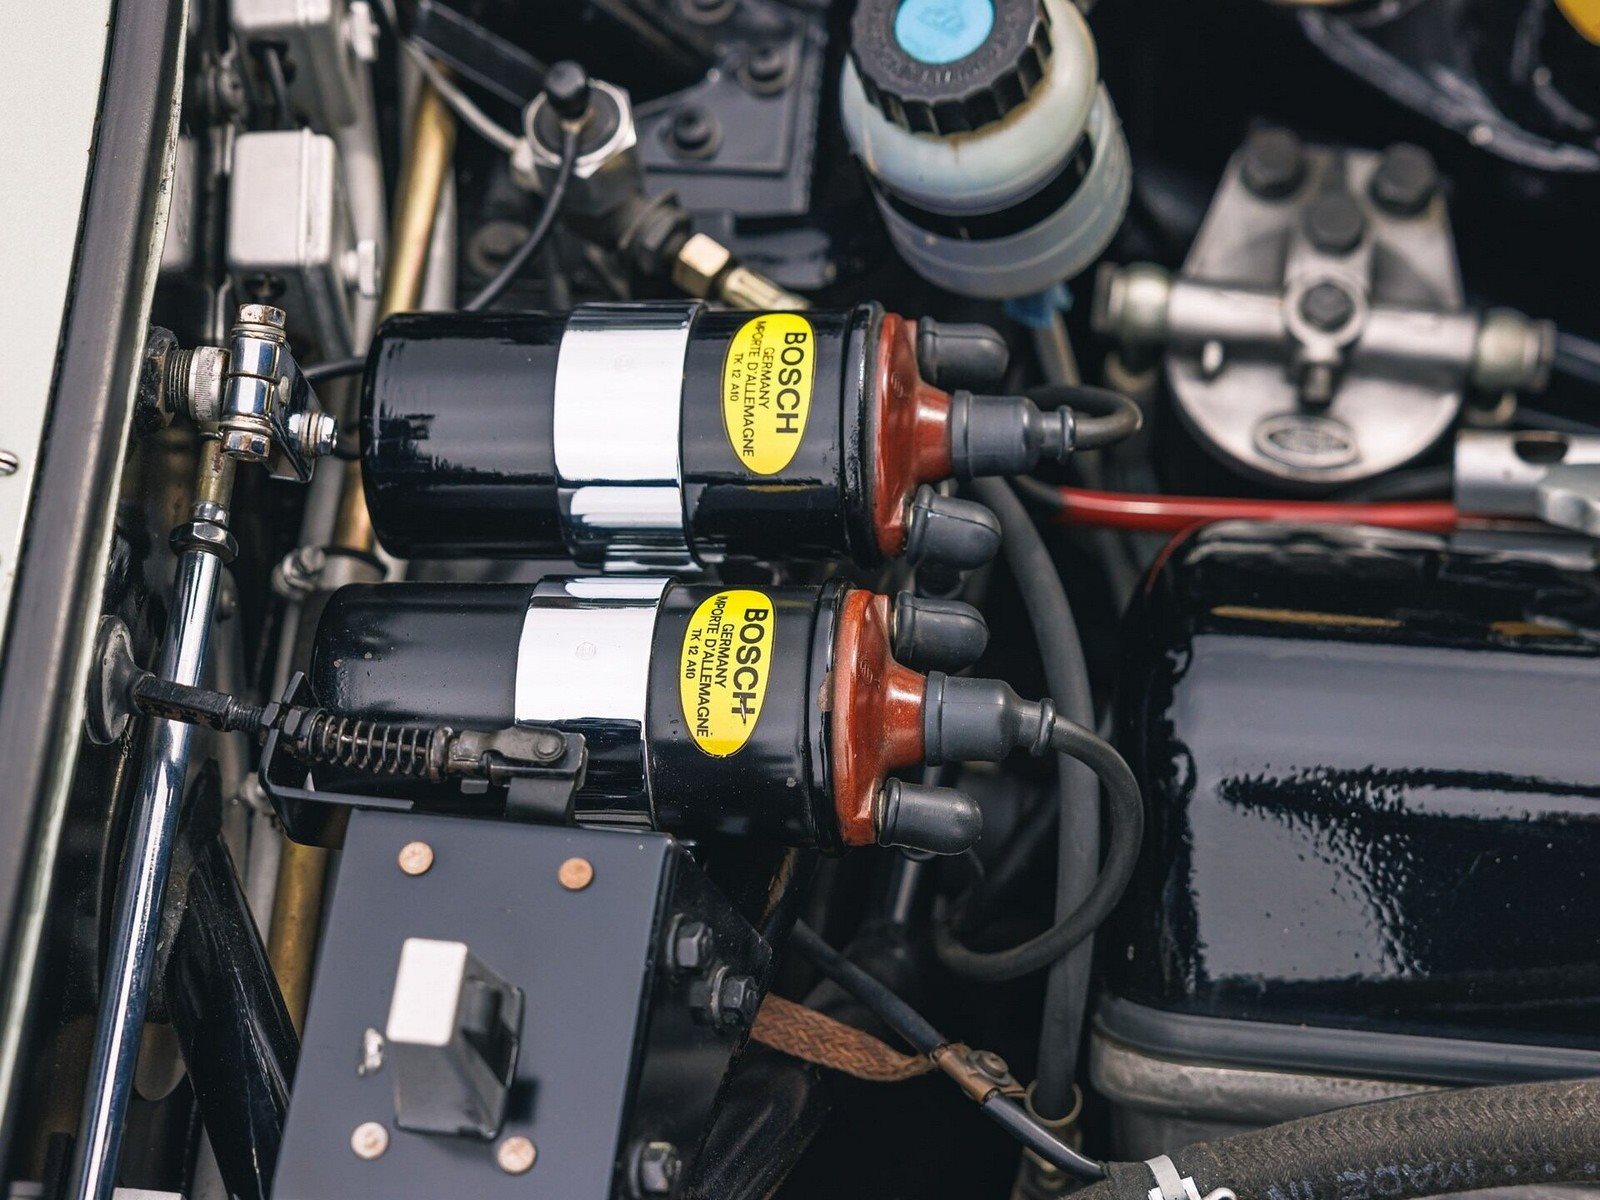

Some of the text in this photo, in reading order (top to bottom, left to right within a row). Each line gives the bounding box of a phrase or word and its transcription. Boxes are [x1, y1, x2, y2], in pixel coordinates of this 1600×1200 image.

[730, 353, 744, 402] TK 12 A10
[742, 362, 759, 457] D'ALLEMAGNE
[758, 347, 775, 410] GERMANY
[776, 332, 807, 434] BOSCH
[685, 628, 703, 680] TK 12 A10
[696, 638, 717, 737] D'ALLEMAGNE
[714, 623, 735, 689] GERMANY
[731, 608, 769, 715] BOSCH
